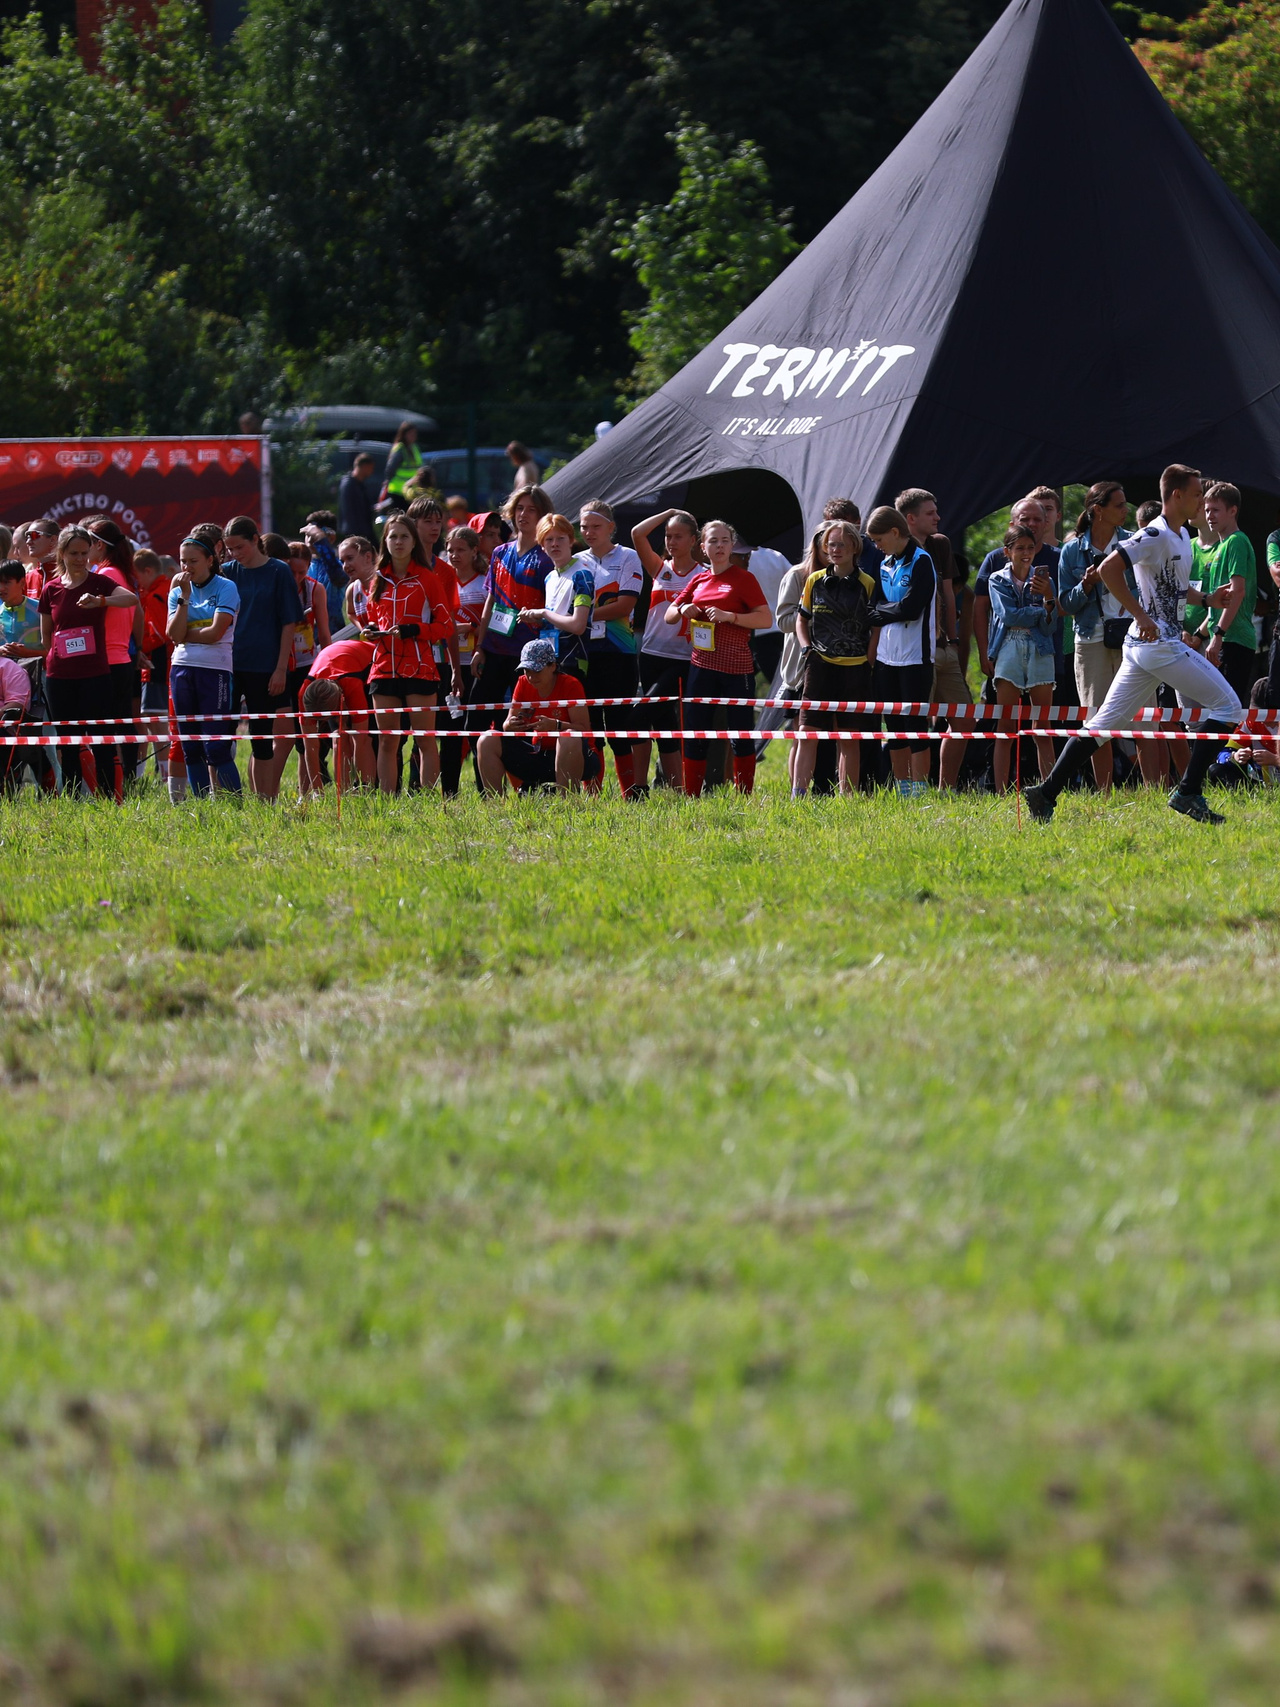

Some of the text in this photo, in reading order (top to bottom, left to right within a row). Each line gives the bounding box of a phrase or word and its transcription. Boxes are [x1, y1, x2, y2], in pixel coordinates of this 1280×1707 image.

[706, 339, 916, 401] TERMIT
[722, 415, 823, 436] IT'S ALL RIDE
